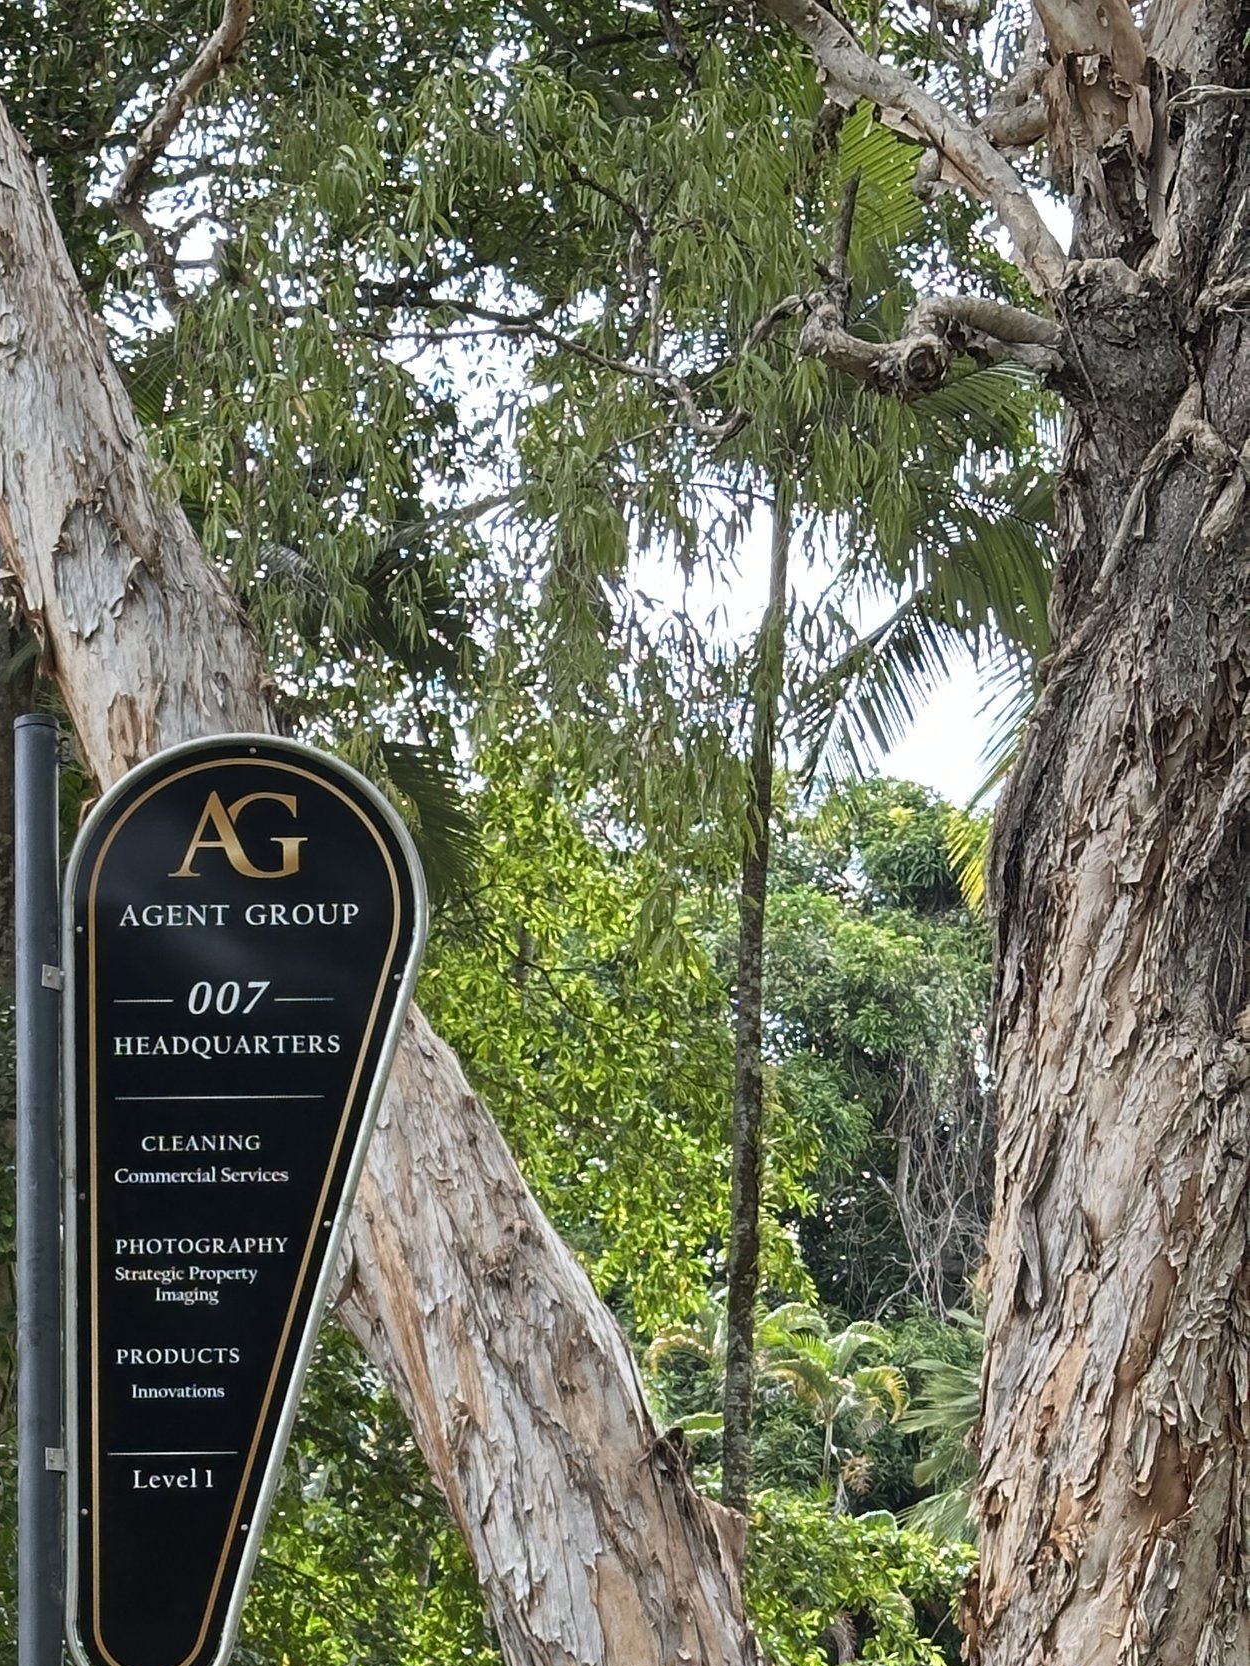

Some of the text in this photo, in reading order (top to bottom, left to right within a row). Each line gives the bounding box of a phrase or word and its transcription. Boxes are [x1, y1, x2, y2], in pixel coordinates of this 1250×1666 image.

[168, 790, 308, 878] AG
[119, 903, 359, 927] AGENT GROUP
[188, 981, 270, 1015] 007
[114, 1034, 341, 1059] HEADQUARTERS
[141, 1134, 261, 1152] CLEANING
[114, 1166, 289, 1184] Commercial Services
[115, 1237, 288, 1255] PHOTOGRAPHY
[115, 1265, 258, 1285] Strategic Property
[155, 1287, 219, 1305] Imaging
[116, 1347, 240, 1365] PRODUCTS
[132, 1384, 225, 1399] Innovations
[133, 1468, 197, 1489] Level
